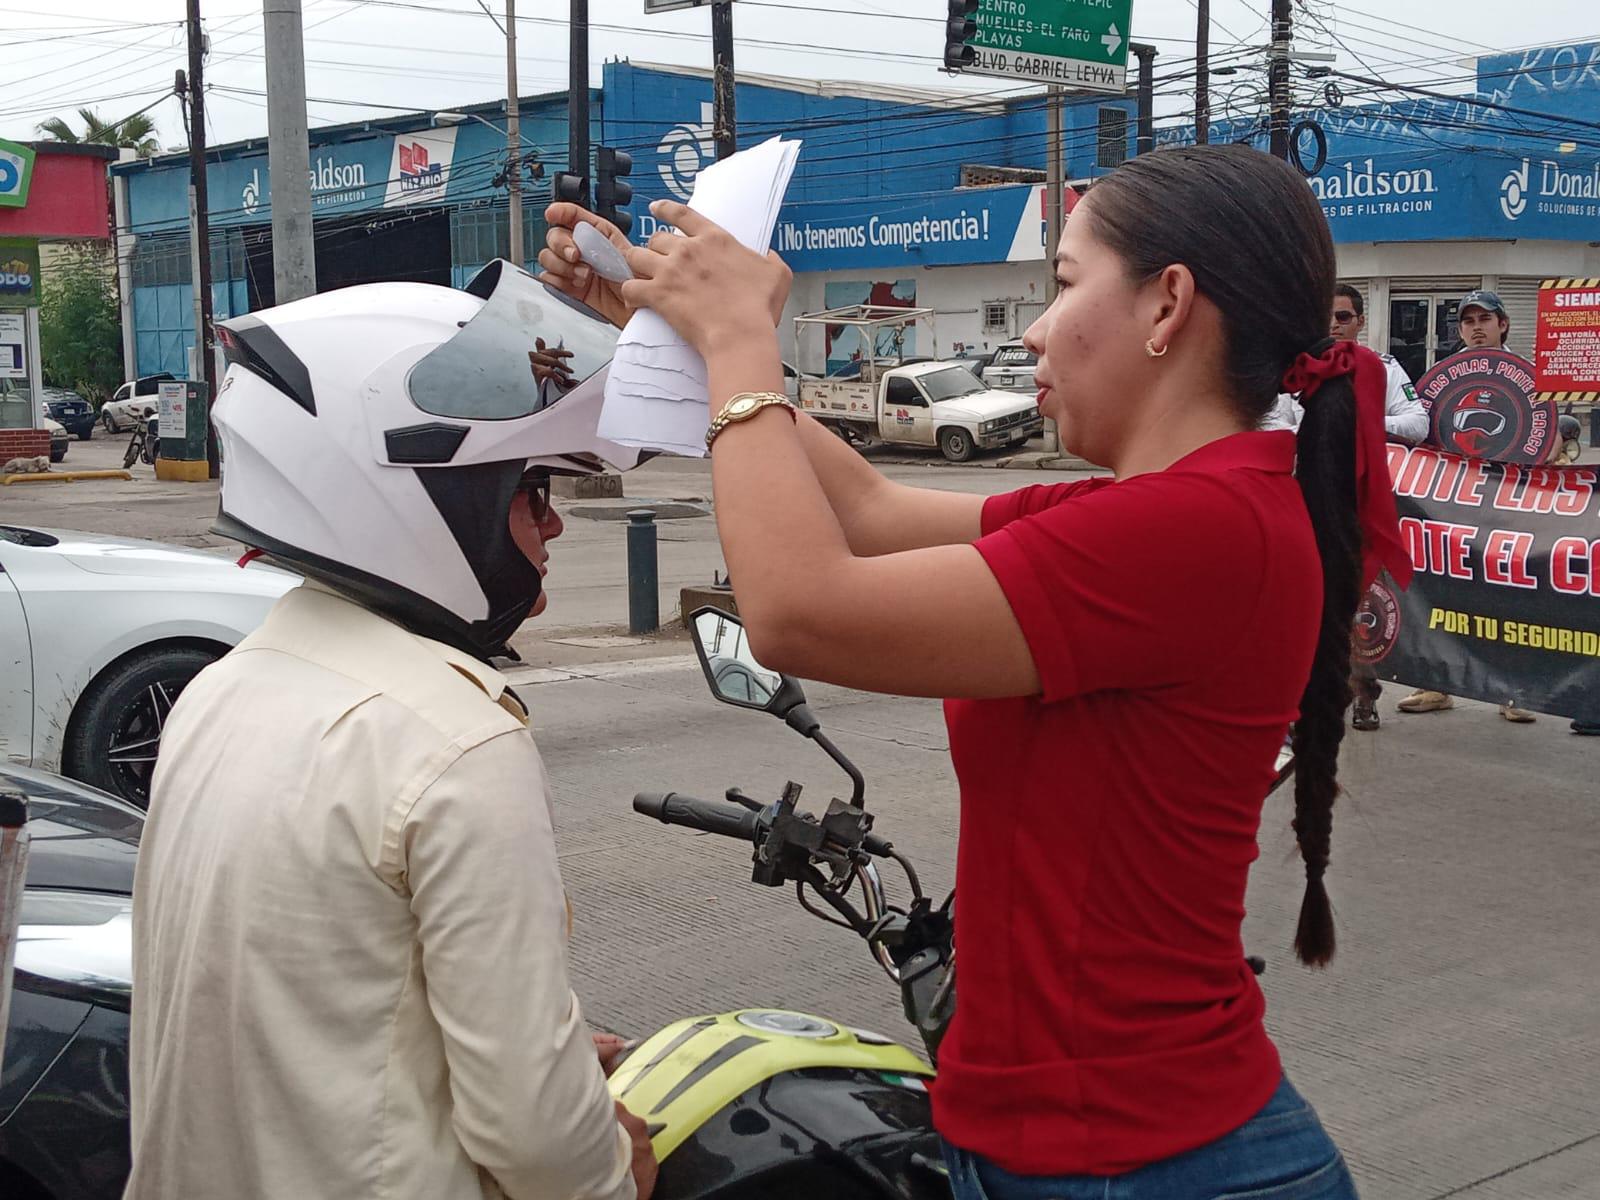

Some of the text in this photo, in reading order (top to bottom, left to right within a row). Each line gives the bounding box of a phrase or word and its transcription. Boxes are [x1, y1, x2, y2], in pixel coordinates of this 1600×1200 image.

[975, 29, 1022, 48] PLAYAS
[973, 52, 1115, 85] BLVD. GABRIEL LEYVA
[1540, 160, 1600, 199] Donal
[1340, 205, 1353, 217] DE
[1357, 200, 1433, 215] FILTRACION
[806, 224, 866, 249] tenemos
[1547, 331, 1558, 339] LA
[1540, 349, 1584, 357] PRODUCEN
[1542, 368, 1559, 376] SON
[1560, 368, 1578, 376] UNA
[1424, 374, 1450, 399] LAS
[1496, 360, 1536, 394] PONTE
[1523, 410, 1548, 456] CASCO
[1493, 462, 1598, 516] LAS
[1483, 529, 1538, 589] EL
[1428, 607, 1470, 635] POR
[1473, 615, 1498, 640] TU
[1503, 620, 1600, 657] SEGURID
